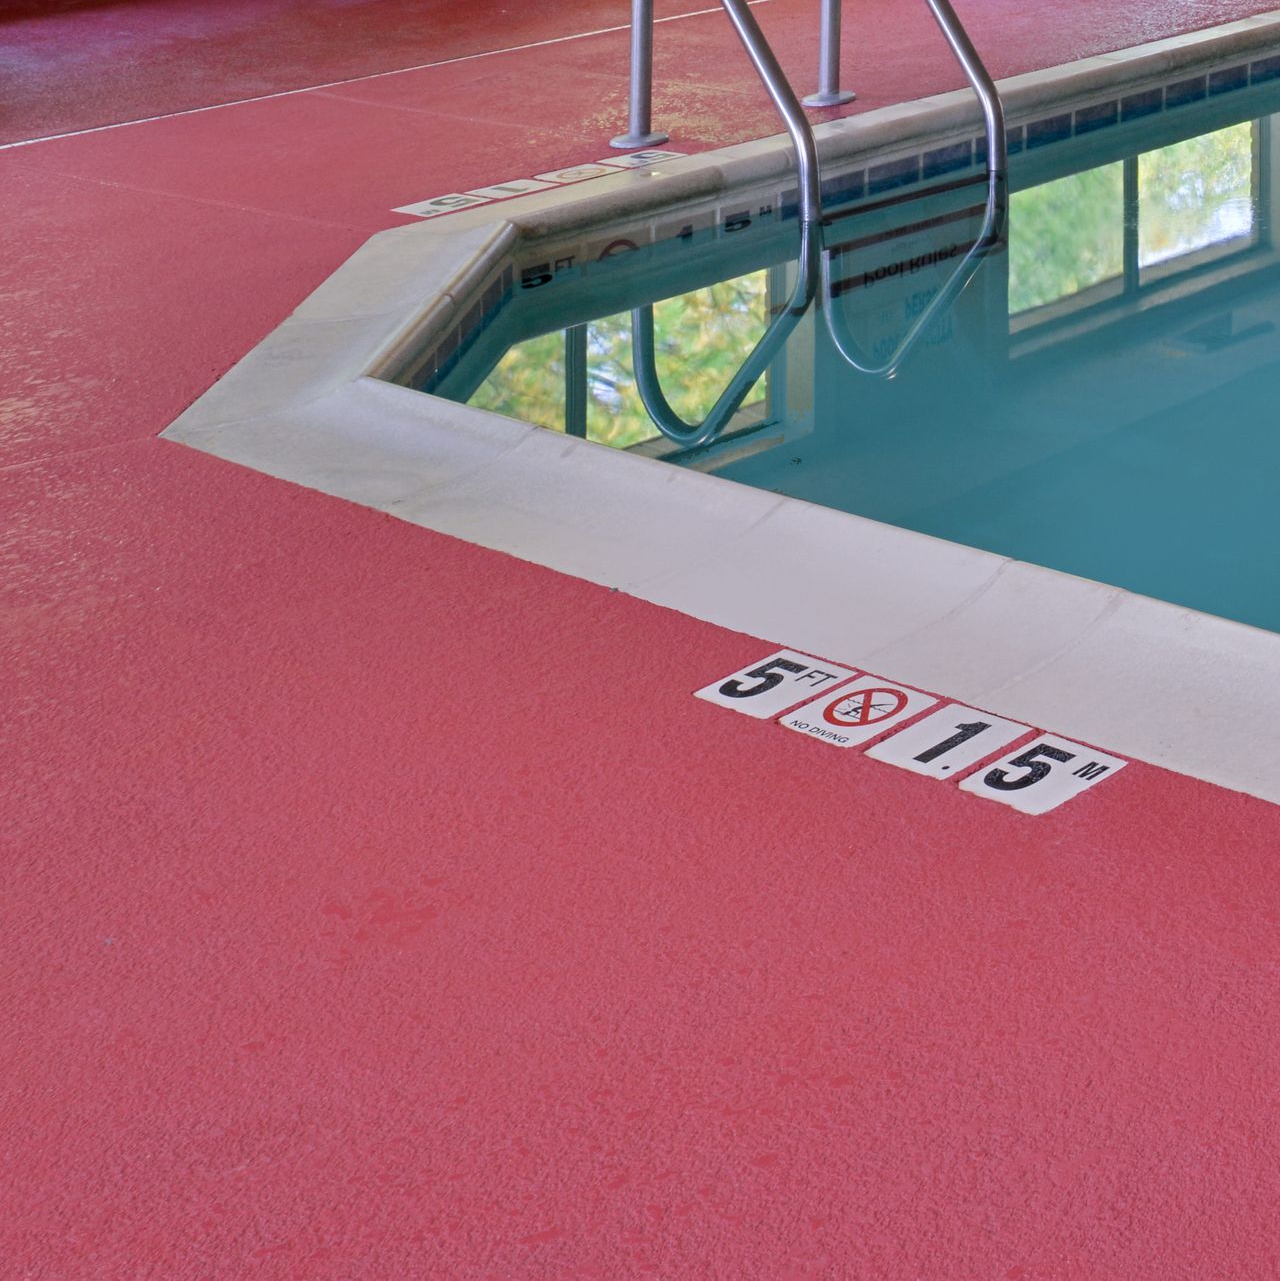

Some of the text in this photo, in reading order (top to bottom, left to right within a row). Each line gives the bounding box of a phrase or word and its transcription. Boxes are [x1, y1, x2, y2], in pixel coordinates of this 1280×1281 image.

[718, 657, 839, 698] 5 FT
[790, 719, 850, 744] NO DIVING
[983, 742, 1077, 791] 5
[1071, 760, 1110, 782] M
